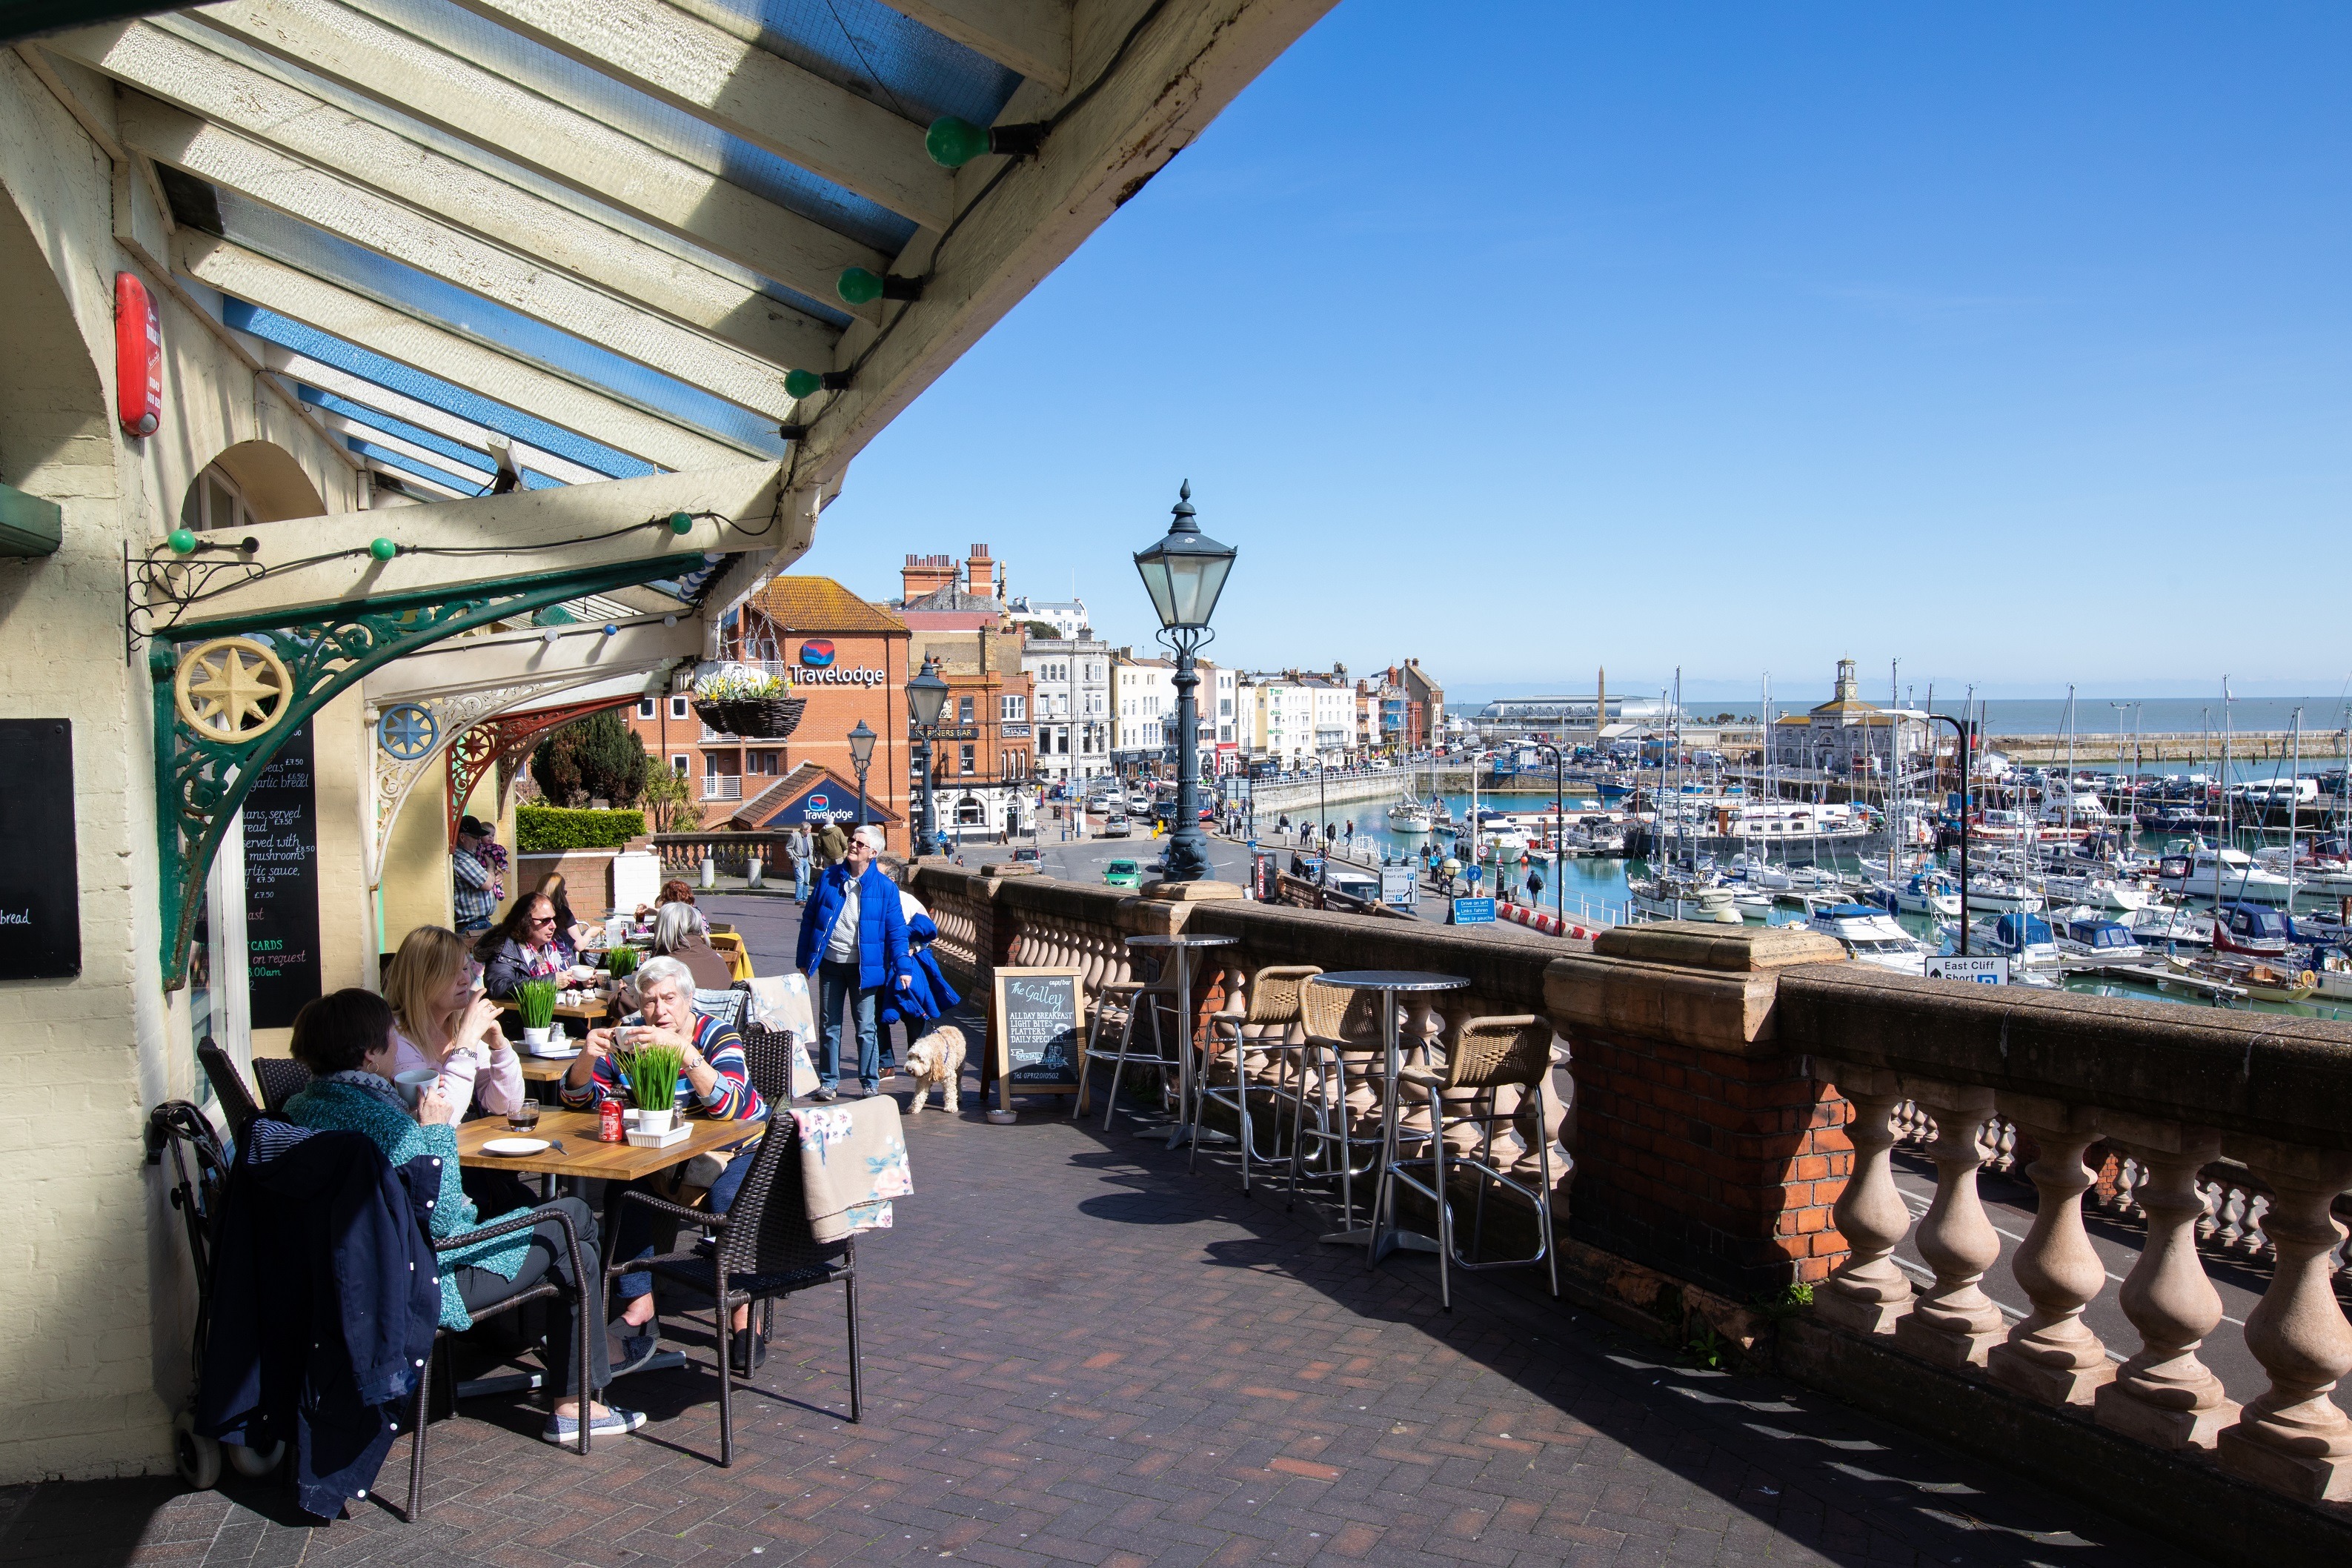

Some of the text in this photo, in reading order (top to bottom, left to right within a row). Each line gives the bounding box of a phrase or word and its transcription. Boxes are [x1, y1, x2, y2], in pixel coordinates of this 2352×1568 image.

[790, 664, 885, 686] Travelodge
[281, 774, 309, 788] bread
[269, 804, 302, 820] served
[803, 808, 854, 821] Travelodge
[244, 833, 300, 848] served with
[249, 848, 305, 861] mushrooms
[269, 867, 300, 877] sauce,
[0, 908, 32, 925] bread
[250, 940, 283, 951] CARDS
[253, 950, 307, 966] on request
[1944, 960, 1995, 970] East Cliff
[1049, 979, 1072, 987] cafe/bar
[1011, 981, 1066, 1014] The Galley
[1037, 1011, 1073, 1020] BREAKFAST
[1010, 1020, 1053, 1028] LIGHT BITES
[1011, 1035, 1063, 1043] DAILY SPECIALS
